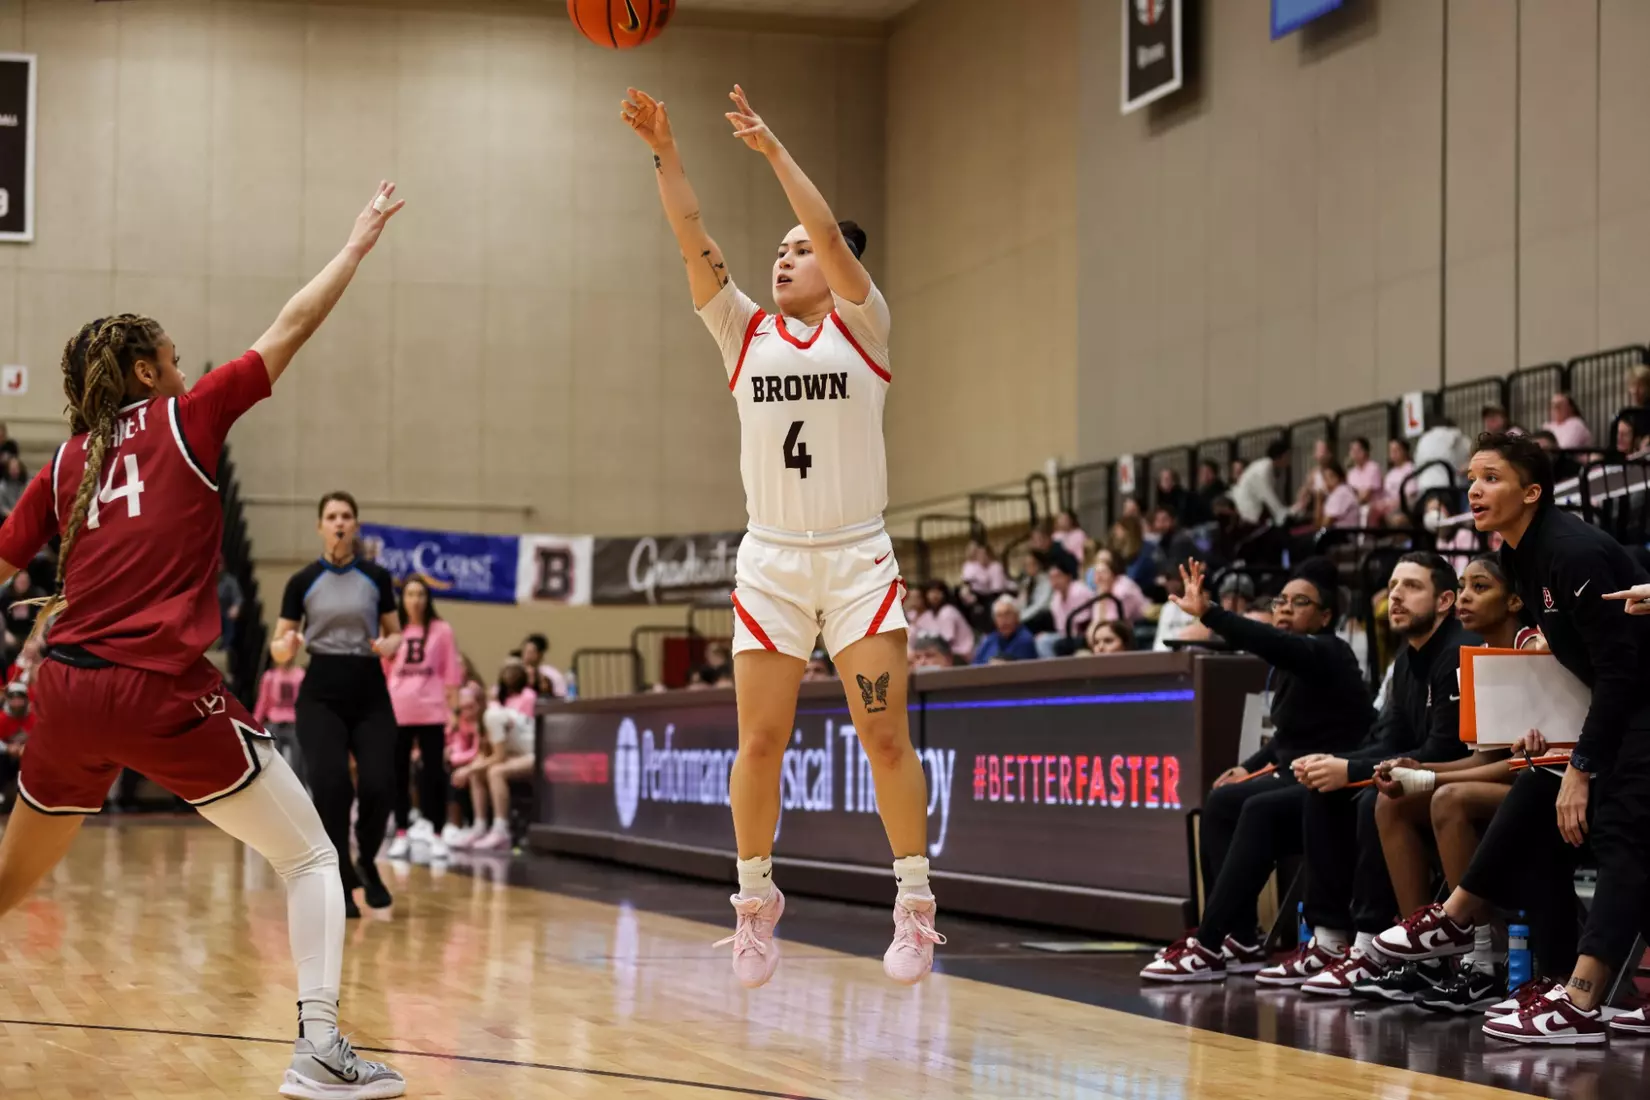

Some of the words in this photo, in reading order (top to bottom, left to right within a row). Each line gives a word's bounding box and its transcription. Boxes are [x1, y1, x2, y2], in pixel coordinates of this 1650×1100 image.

[8, 370, 22, 390] J
[751, 372, 848, 402] BROWN
[783, 420, 812, 479] 4
[534, 545, 576, 602] B
[405, 638, 425, 664] B
[641, 723, 739, 806] Performanc
[973, 755, 1182, 809] #BETTERFASTER
